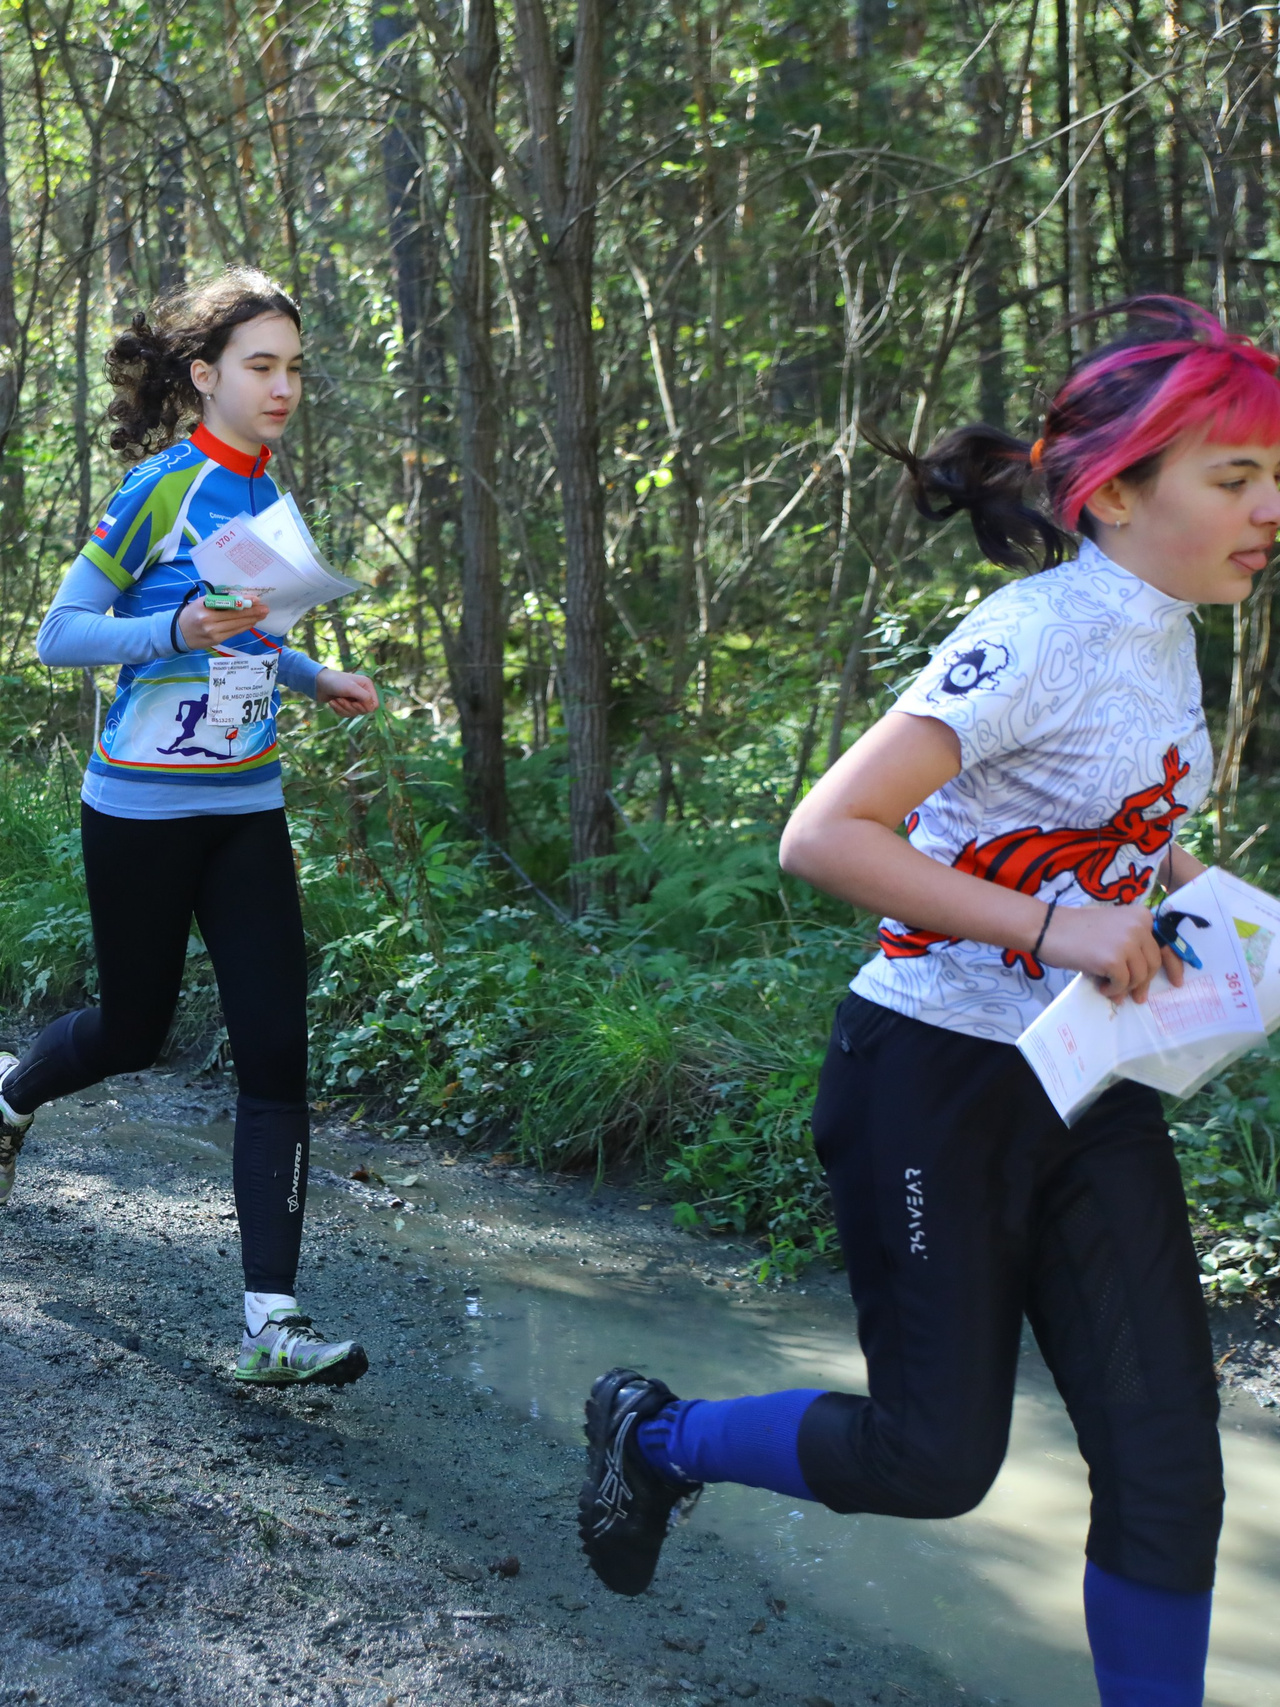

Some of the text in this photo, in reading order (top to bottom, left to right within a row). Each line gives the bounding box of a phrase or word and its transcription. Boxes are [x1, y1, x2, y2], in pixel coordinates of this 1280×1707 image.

[215, 530, 236, 548] 370.1
[242, 696, 269, 724] 370
[1225, 971, 1248, 1009] 361.1
[292, 1142, 302, 1194] NORD
